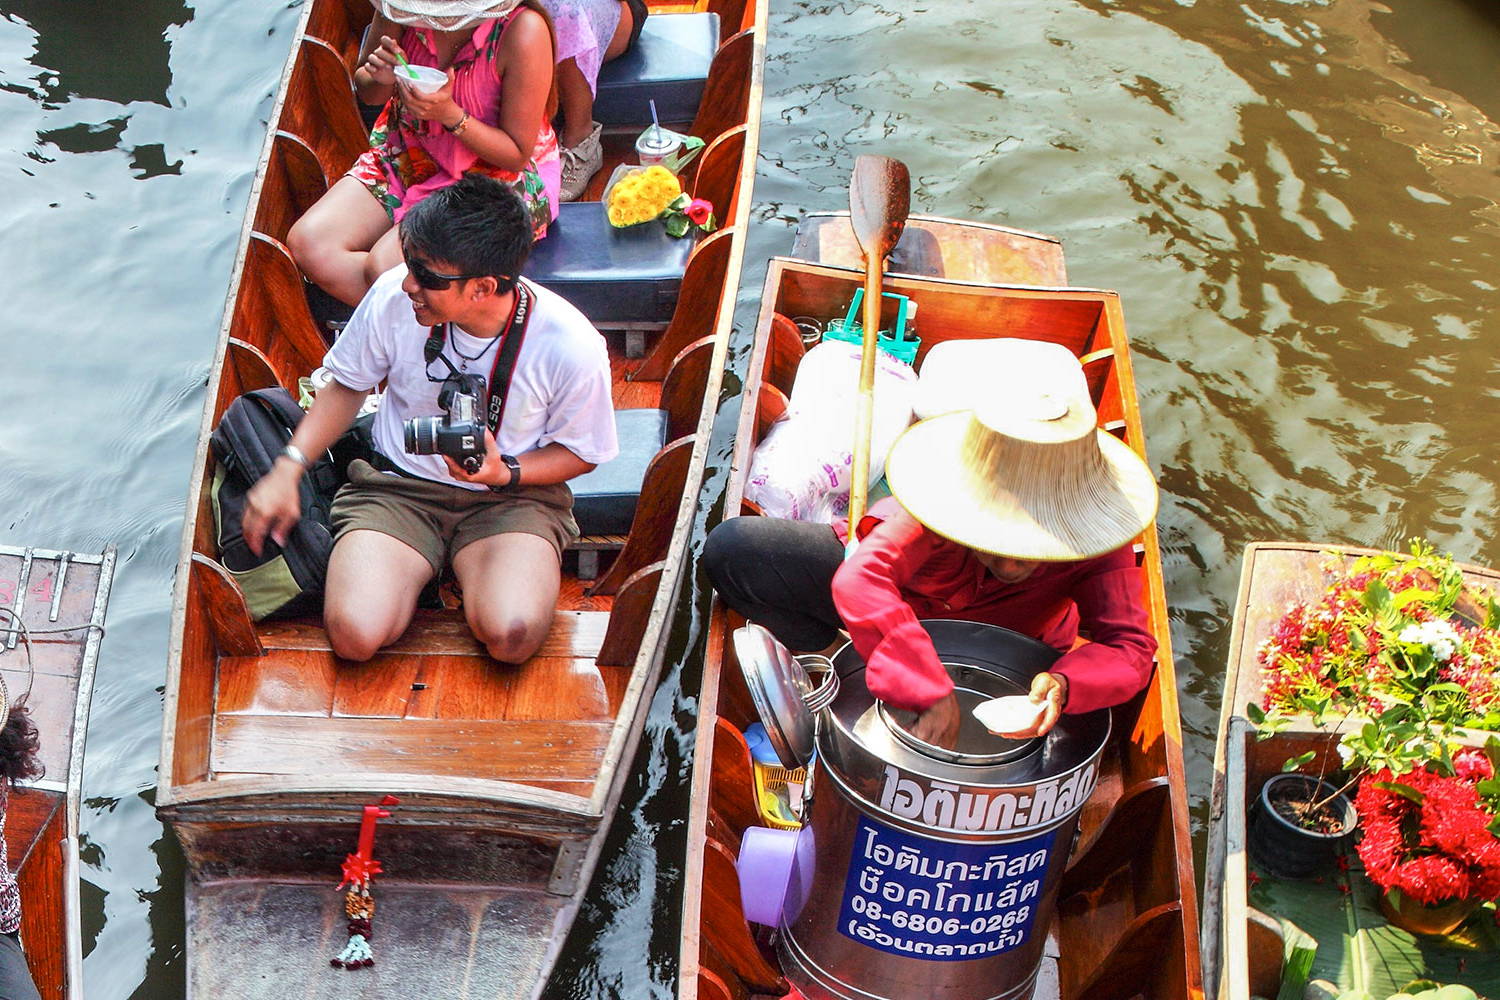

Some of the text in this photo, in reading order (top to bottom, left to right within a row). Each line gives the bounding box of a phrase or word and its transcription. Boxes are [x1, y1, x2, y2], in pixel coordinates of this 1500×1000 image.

[515, 281, 528, 324] Canon
[488, 395, 502, 423] EOS
[880, 763, 1096, 831] ไอติมกะทิสด
[863, 826, 1047, 881] ไอติมกะทิสด
[851, 895, 1030, 935] 08-6806-0268
